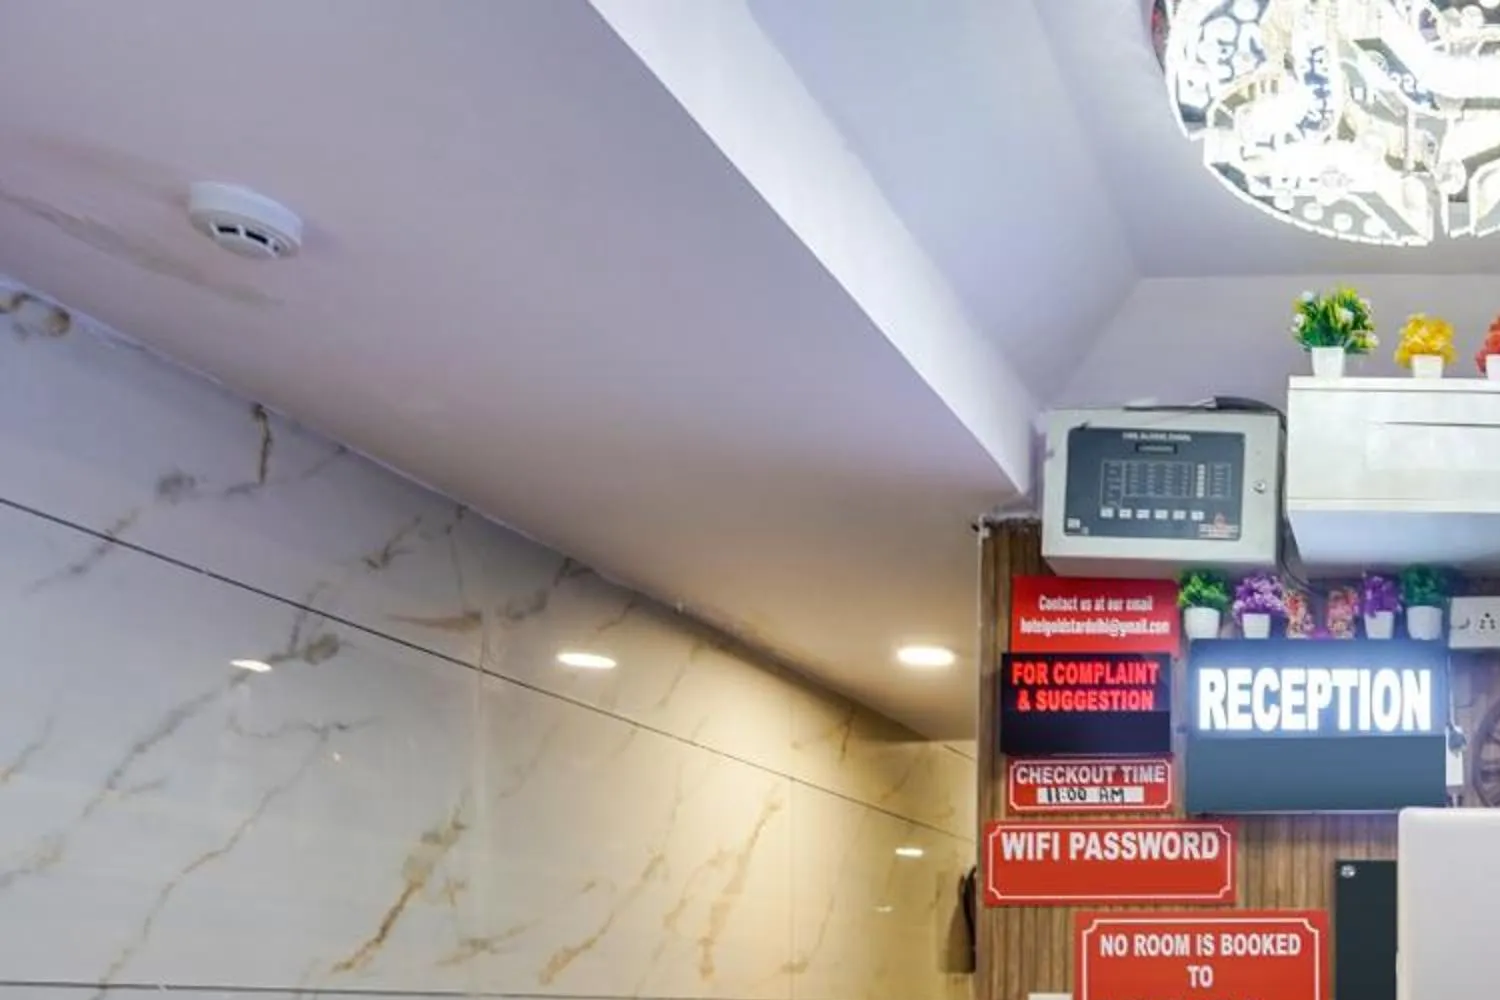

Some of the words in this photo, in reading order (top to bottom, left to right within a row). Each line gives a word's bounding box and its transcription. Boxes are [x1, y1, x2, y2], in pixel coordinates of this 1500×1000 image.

[1012, 662, 1048, 684] FOR
[1053, 661, 1159, 684] COMPLAINT
[1018, 690, 1031, 711] &
[1036, 689, 1153, 711] SUGGESTION
[1199, 667, 1432, 732] RECEPTION
[1016, 766, 1117, 784] CHECKOUT
[1121, 765, 1166, 783] TIME
[1099, 787, 1124, 801] AM
[1001, 832, 1060, 860] WIFI
[1069, 832, 1219, 860] PASSWORD
[1101, 934, 1127, 956] NO
[1134, 934, 1190, 956] ROOM
[1197, 934, 1214, 955] IS
[1220, 934, 1301, 955] BOOKED
[1187, 966, 1213, 988] TO
